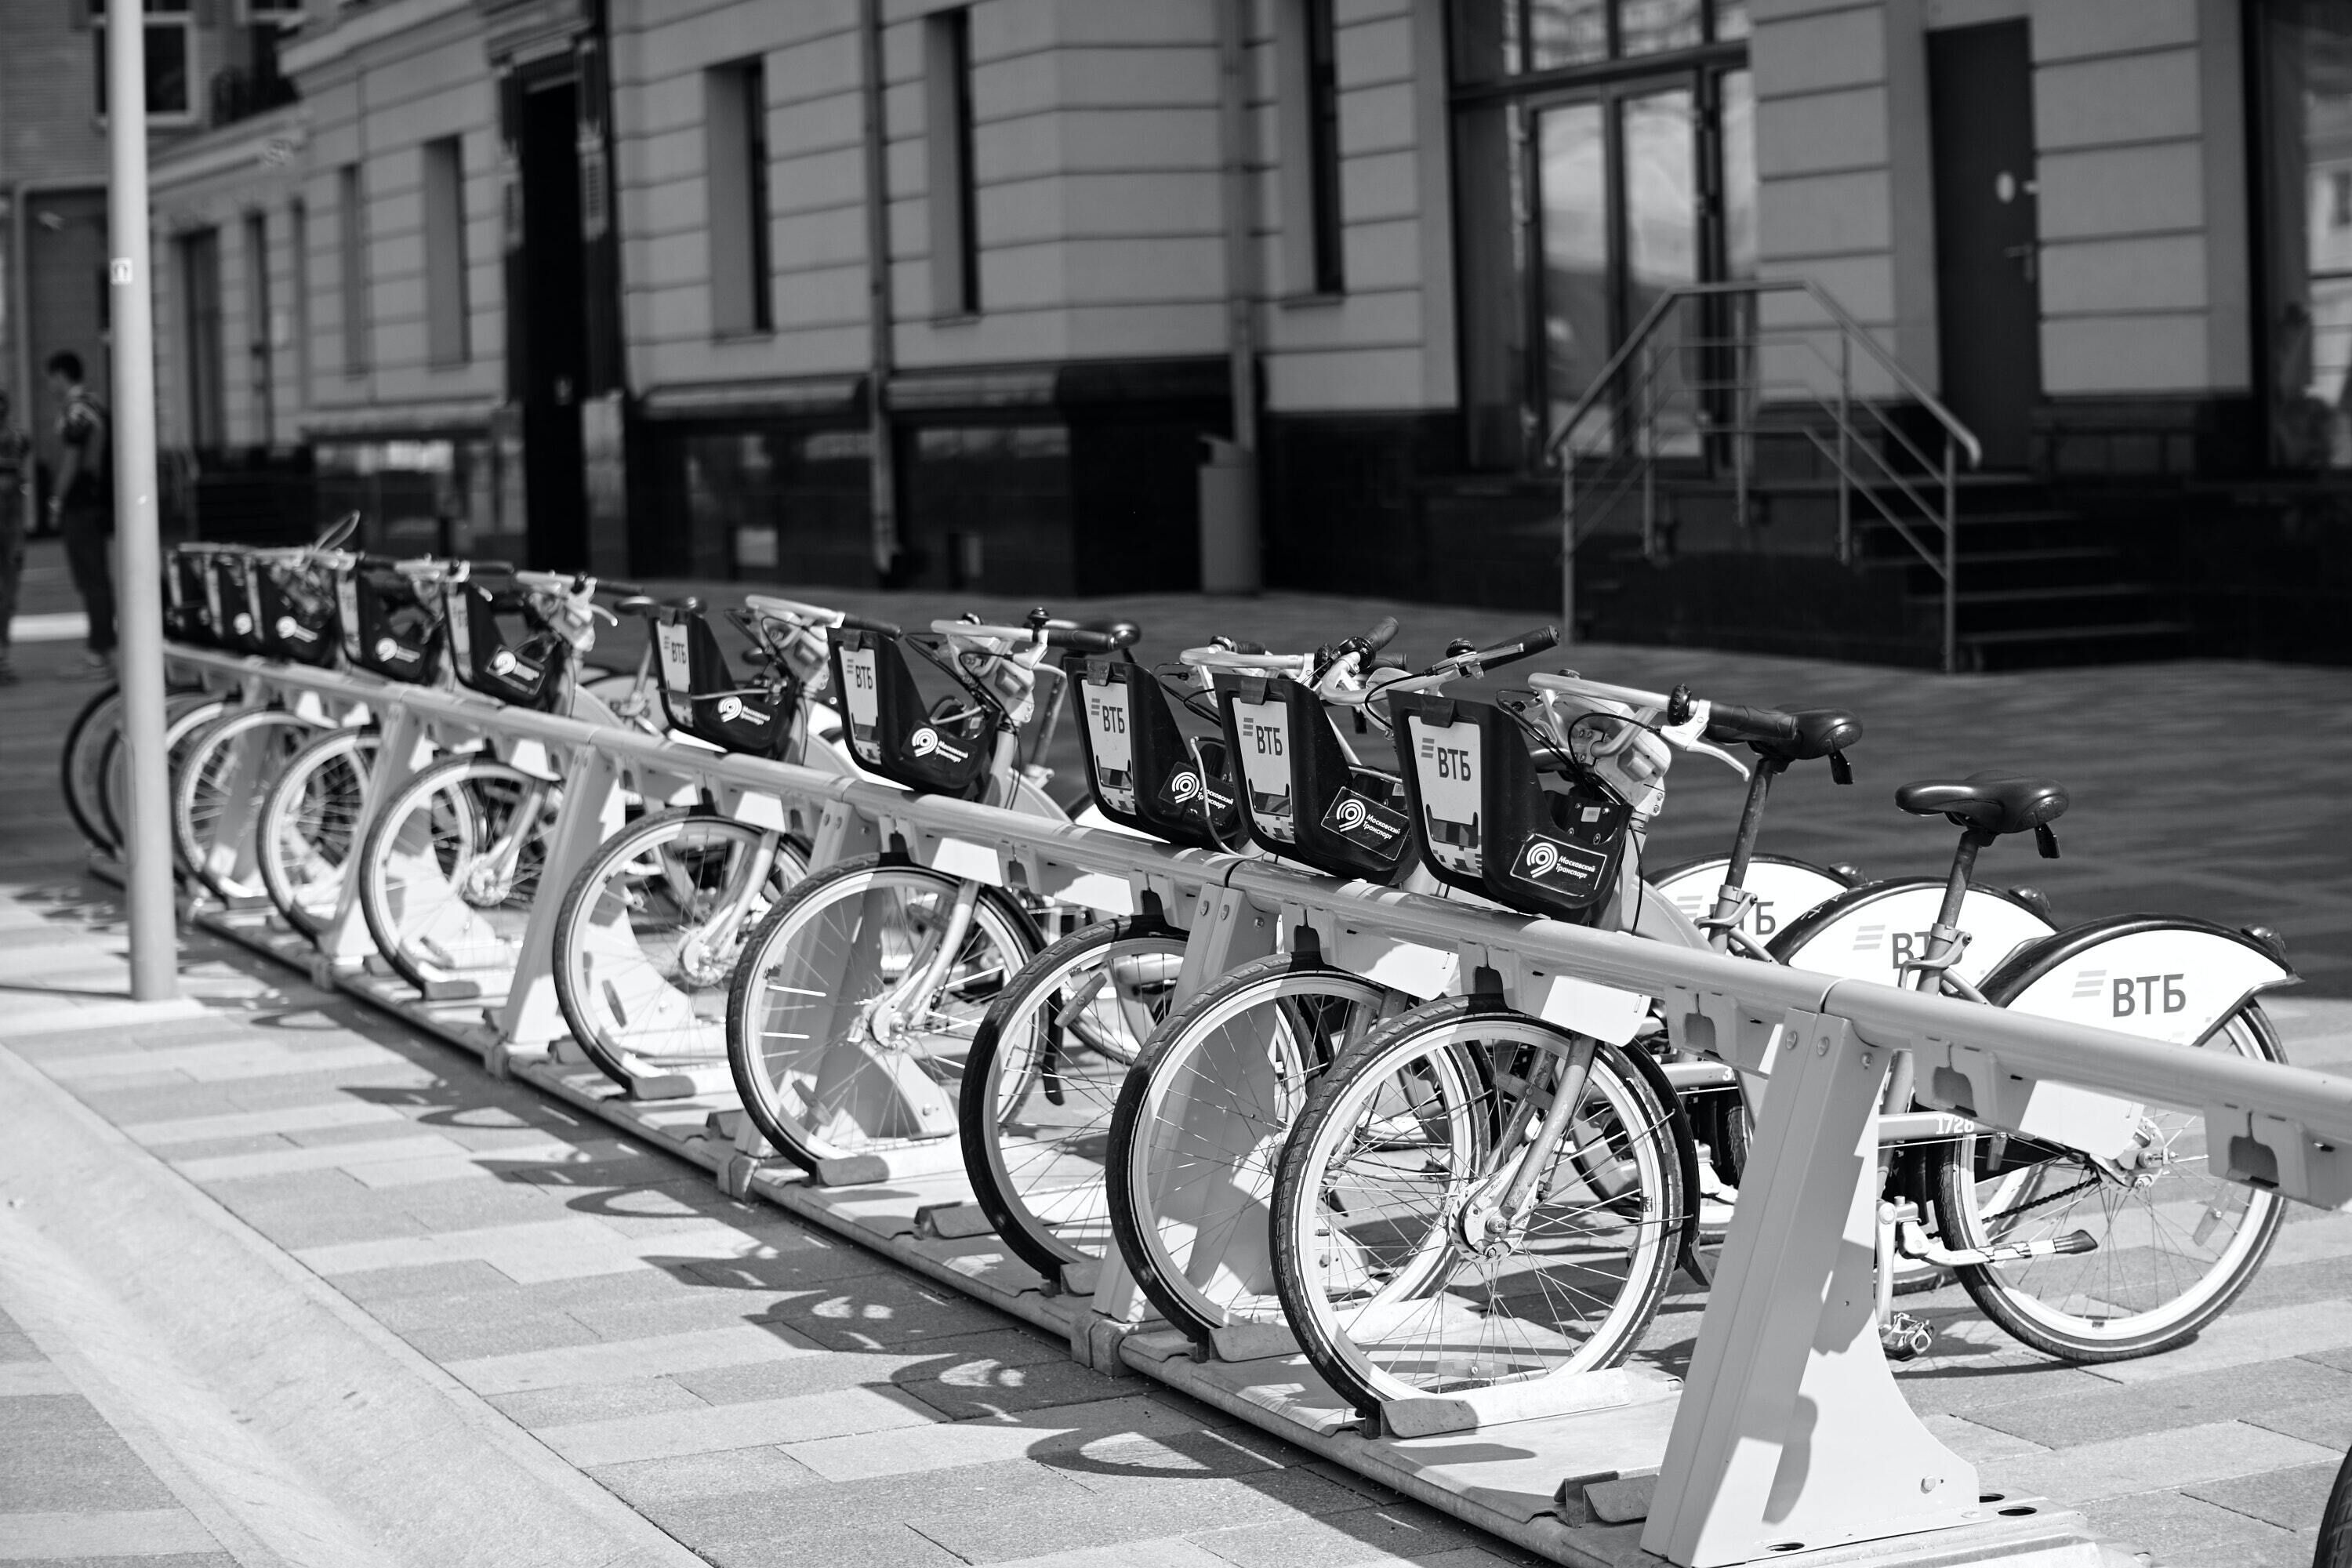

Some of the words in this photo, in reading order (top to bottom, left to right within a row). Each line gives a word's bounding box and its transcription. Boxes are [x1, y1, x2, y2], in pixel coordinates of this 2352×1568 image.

[671, 642, 687, 664] ВТБ
[855, 665, 873, 690] ВТБ
[1102, 706, 1125, 734] ВТБ
[1256, 725, 1283, 756] ВТБ
[1437, 747, 1472, 782] ВТБ
[1363, 820, 1393, 840] Транспорт
[1366, 813, 1401, 835] Московский
[1555, 863, 1588, 879] Транспорт
[1558, 855, 1596, 873] Московский
[2113, 973, 2187, 1018] ВТБ
